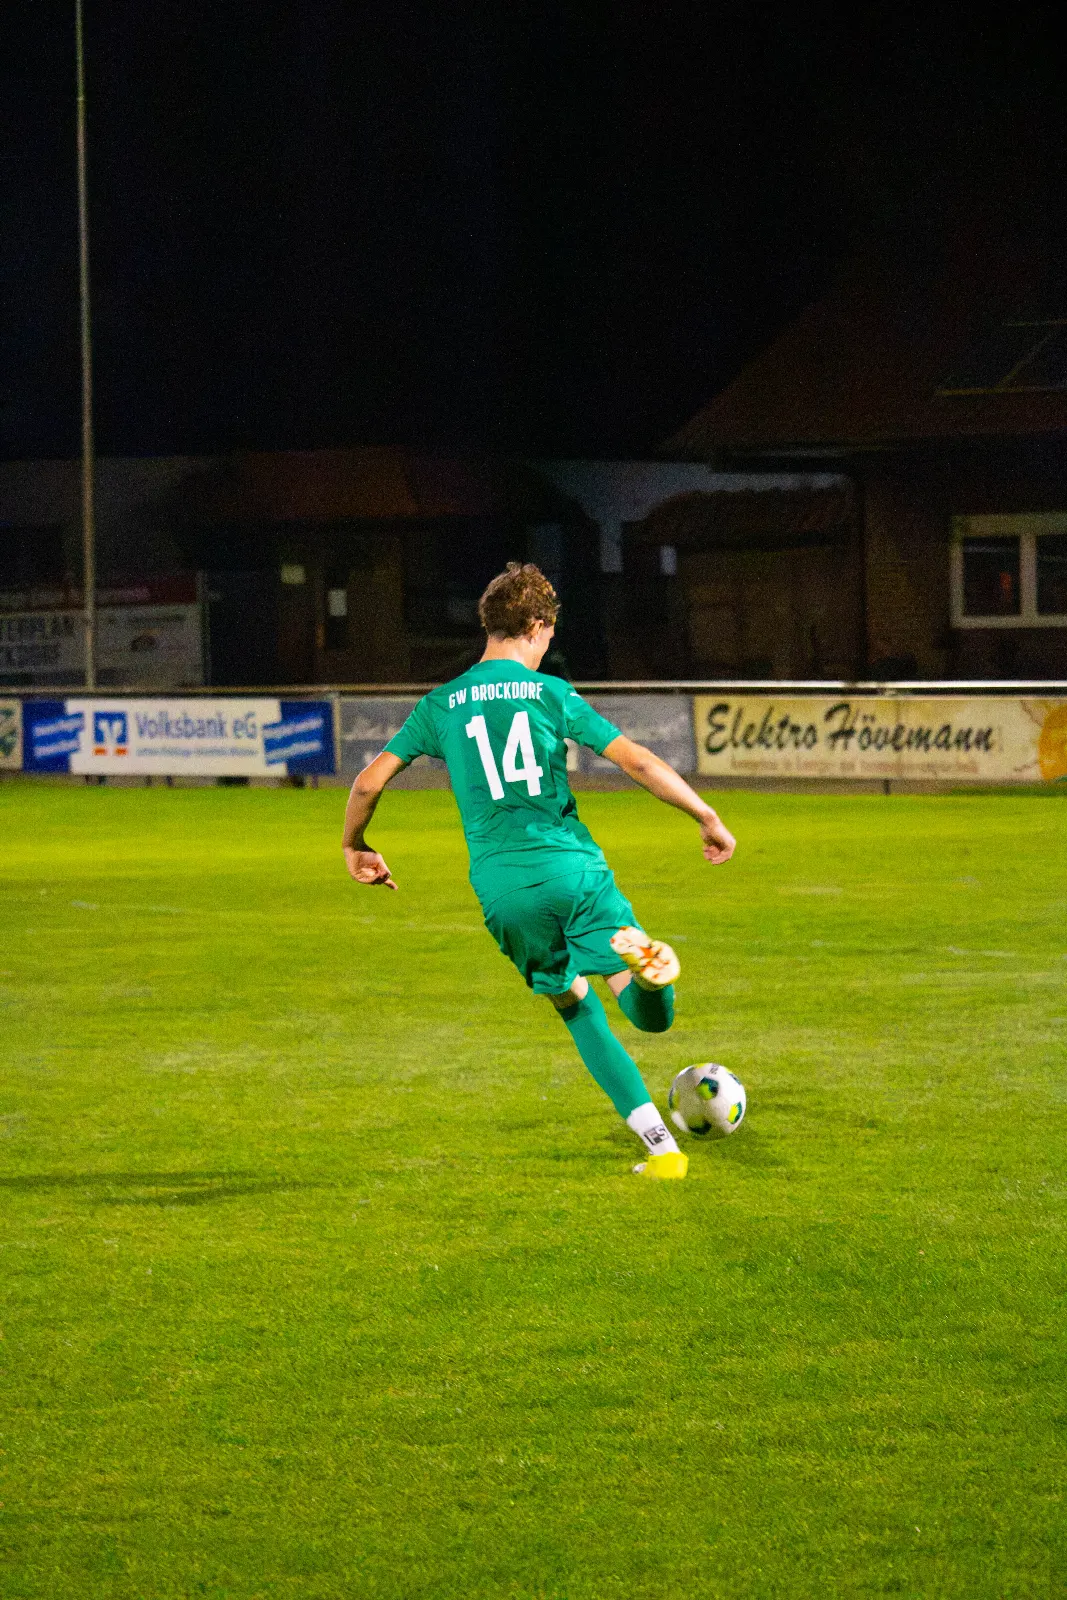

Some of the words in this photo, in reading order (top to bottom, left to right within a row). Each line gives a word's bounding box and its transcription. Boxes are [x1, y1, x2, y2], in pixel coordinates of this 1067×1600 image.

[448, 687, 467, 709] GW
[471, 681, 544, 702] BROCKDORF
[135, 711, 228, 740] Volksbank
[232, 711, 258, 740] eG
[705, 702, 818, 755] Elektro
[824, 702, 994, 754] Hövemann
[465, 710, 544, 801] 14
